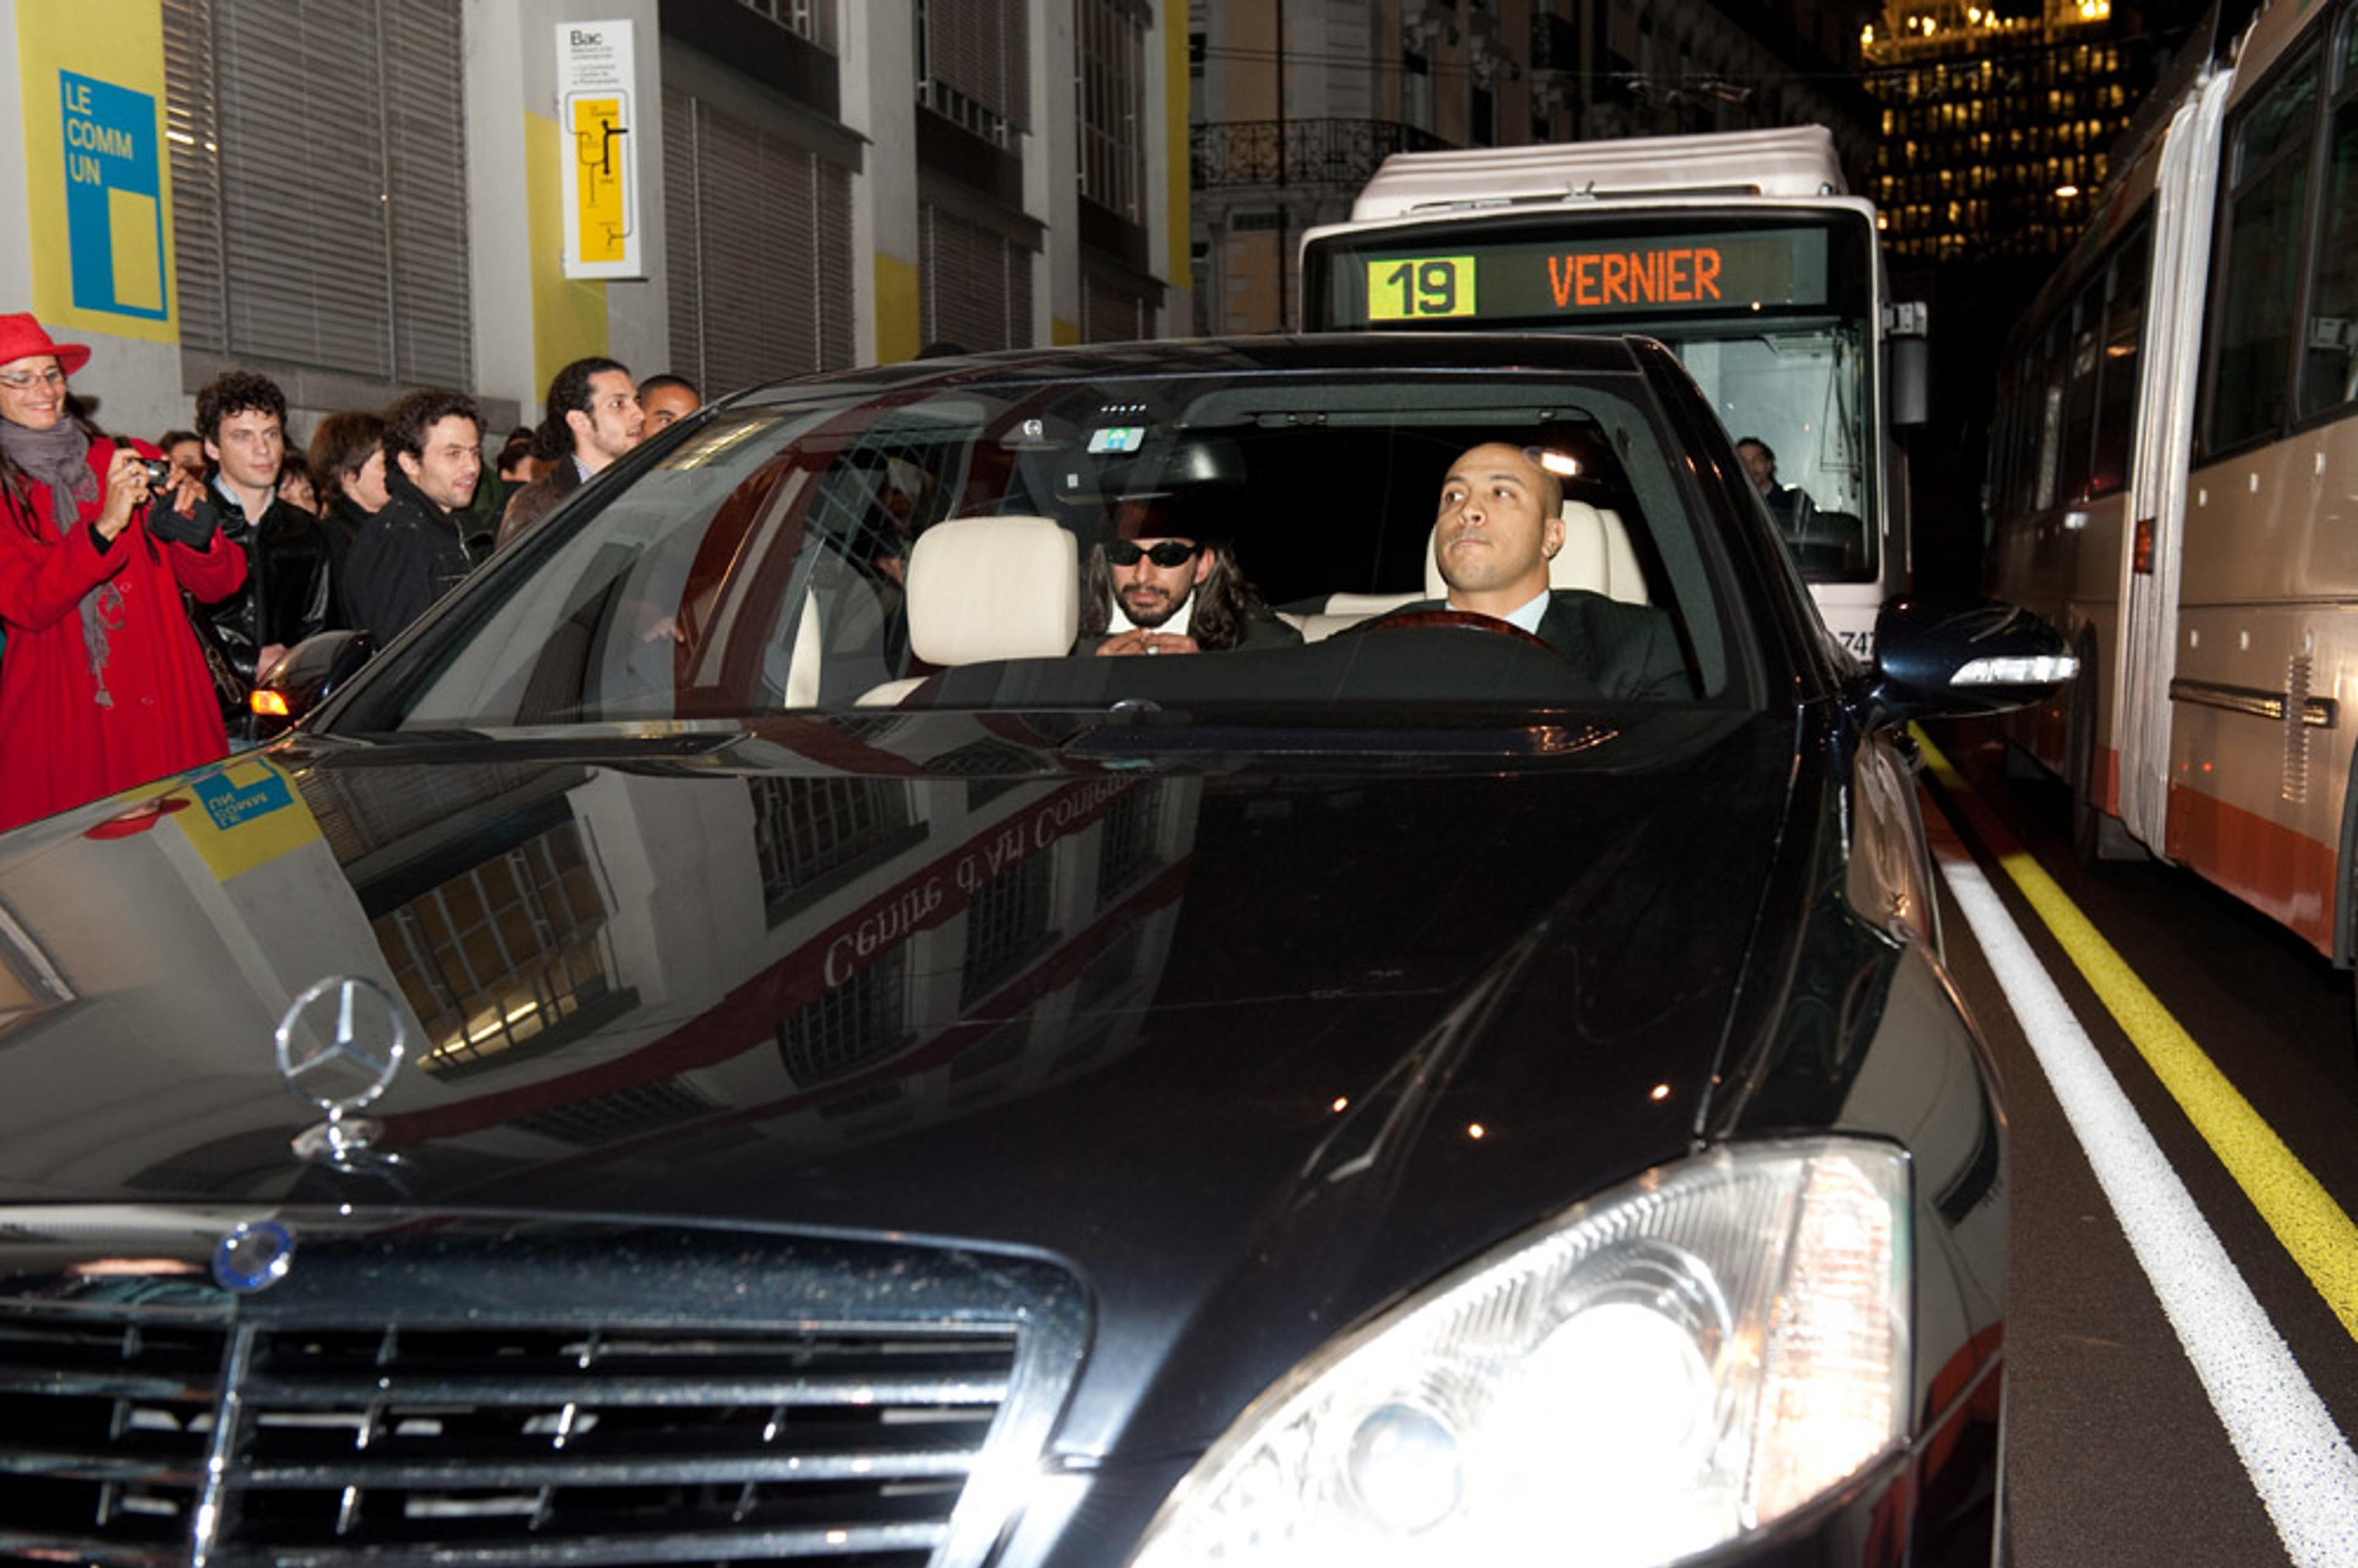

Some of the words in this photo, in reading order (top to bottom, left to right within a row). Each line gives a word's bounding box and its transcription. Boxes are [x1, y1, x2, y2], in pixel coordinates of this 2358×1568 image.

[570, 29, 602, 45] Bac
[65, 81, 92, 115] LE
[68, 118, 133, 160] COMM
[69, 152, 101, 186] UN
[1387, 261, 1457, 316] 19
[1548, 248, 1722, 307] VERNIER
